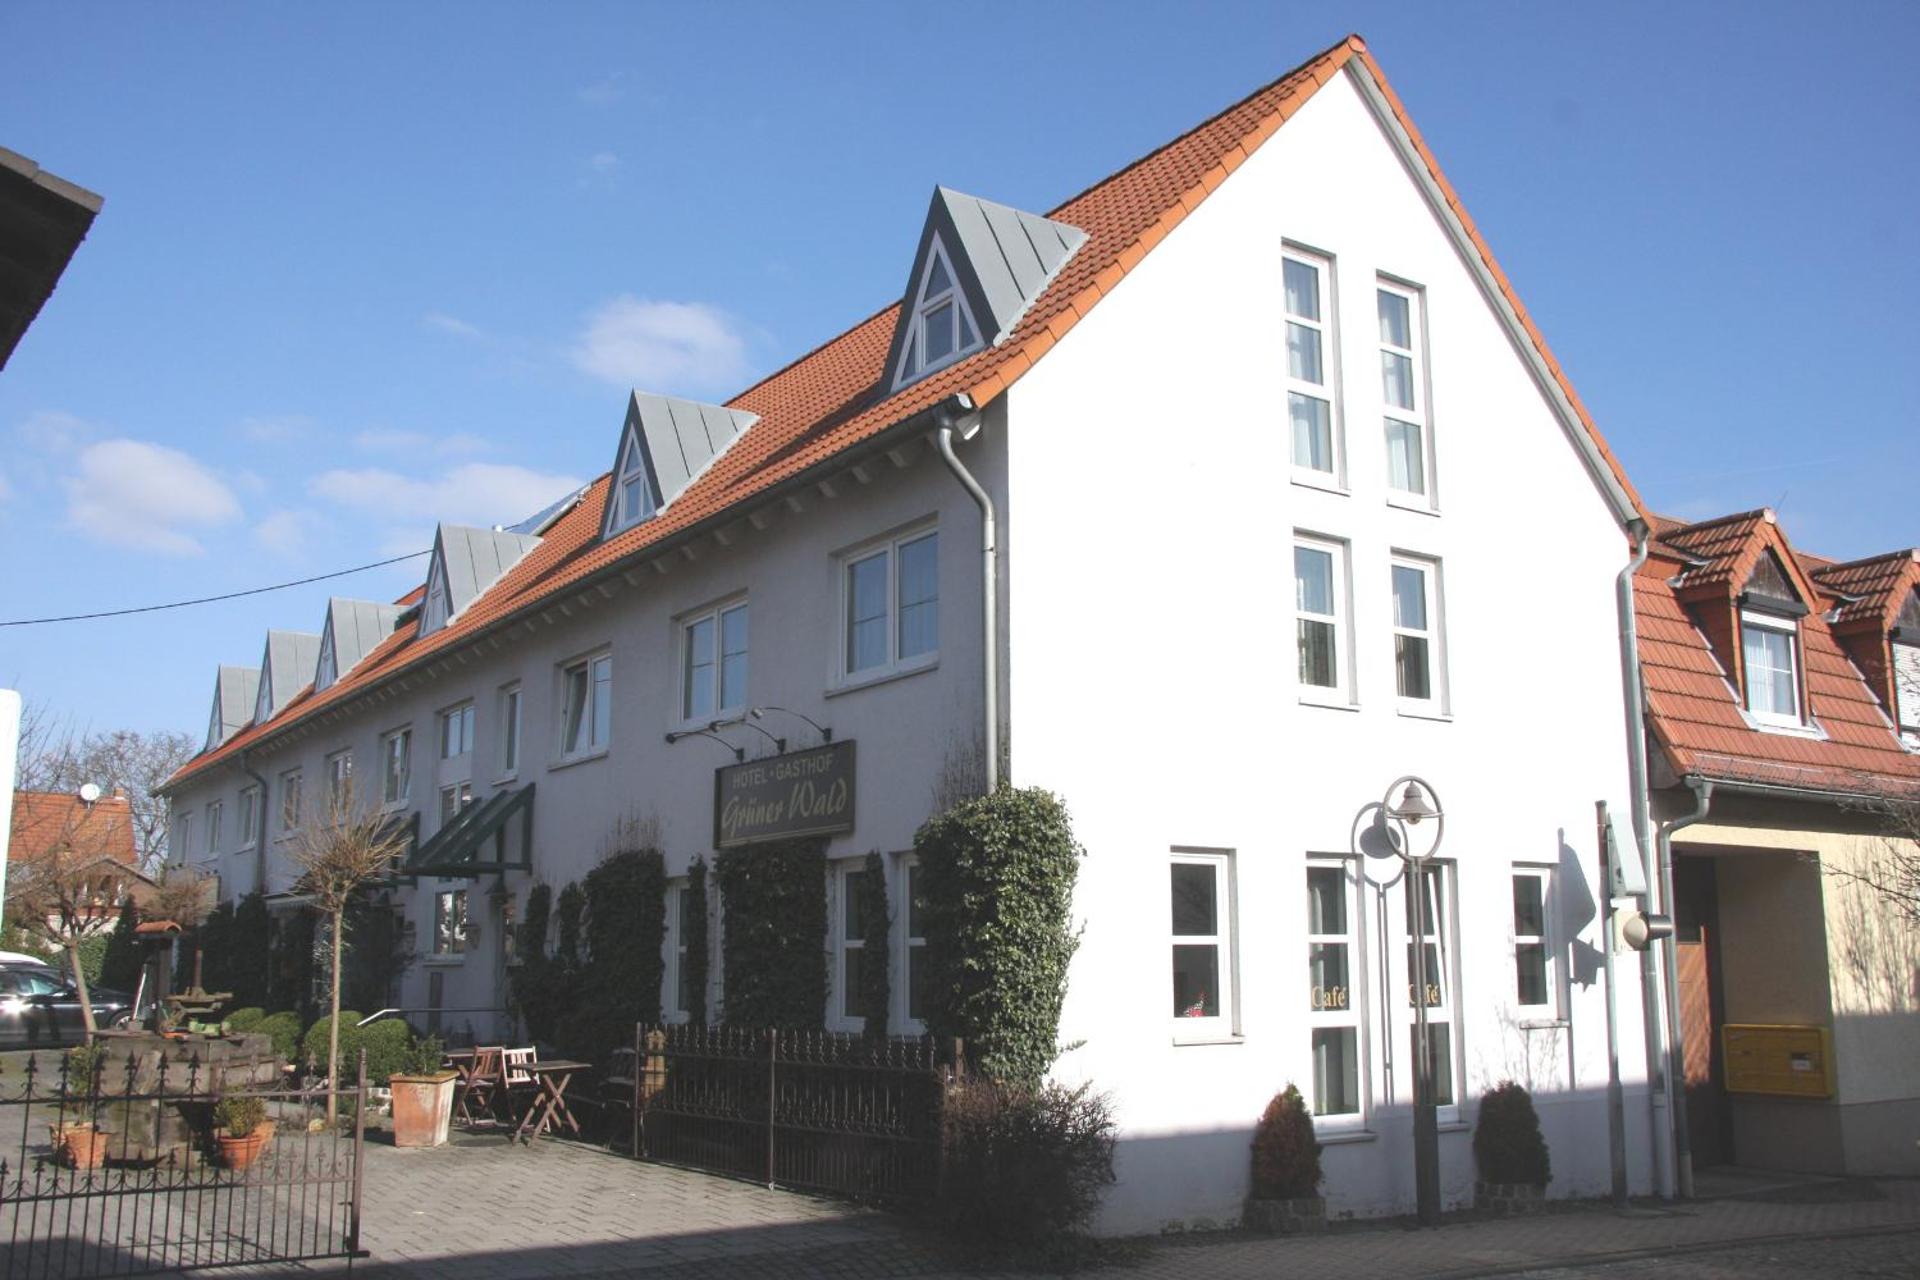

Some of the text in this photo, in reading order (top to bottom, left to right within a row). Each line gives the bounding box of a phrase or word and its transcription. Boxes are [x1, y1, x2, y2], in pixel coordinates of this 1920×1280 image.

[732, 753, 833, 789] HOTEL GASTHOF
[721, 777, 848, 838] Grüner Wald
[1311, 985, 1347, 1008] Café
[1408, 983, 1439, 1005] Cfé
